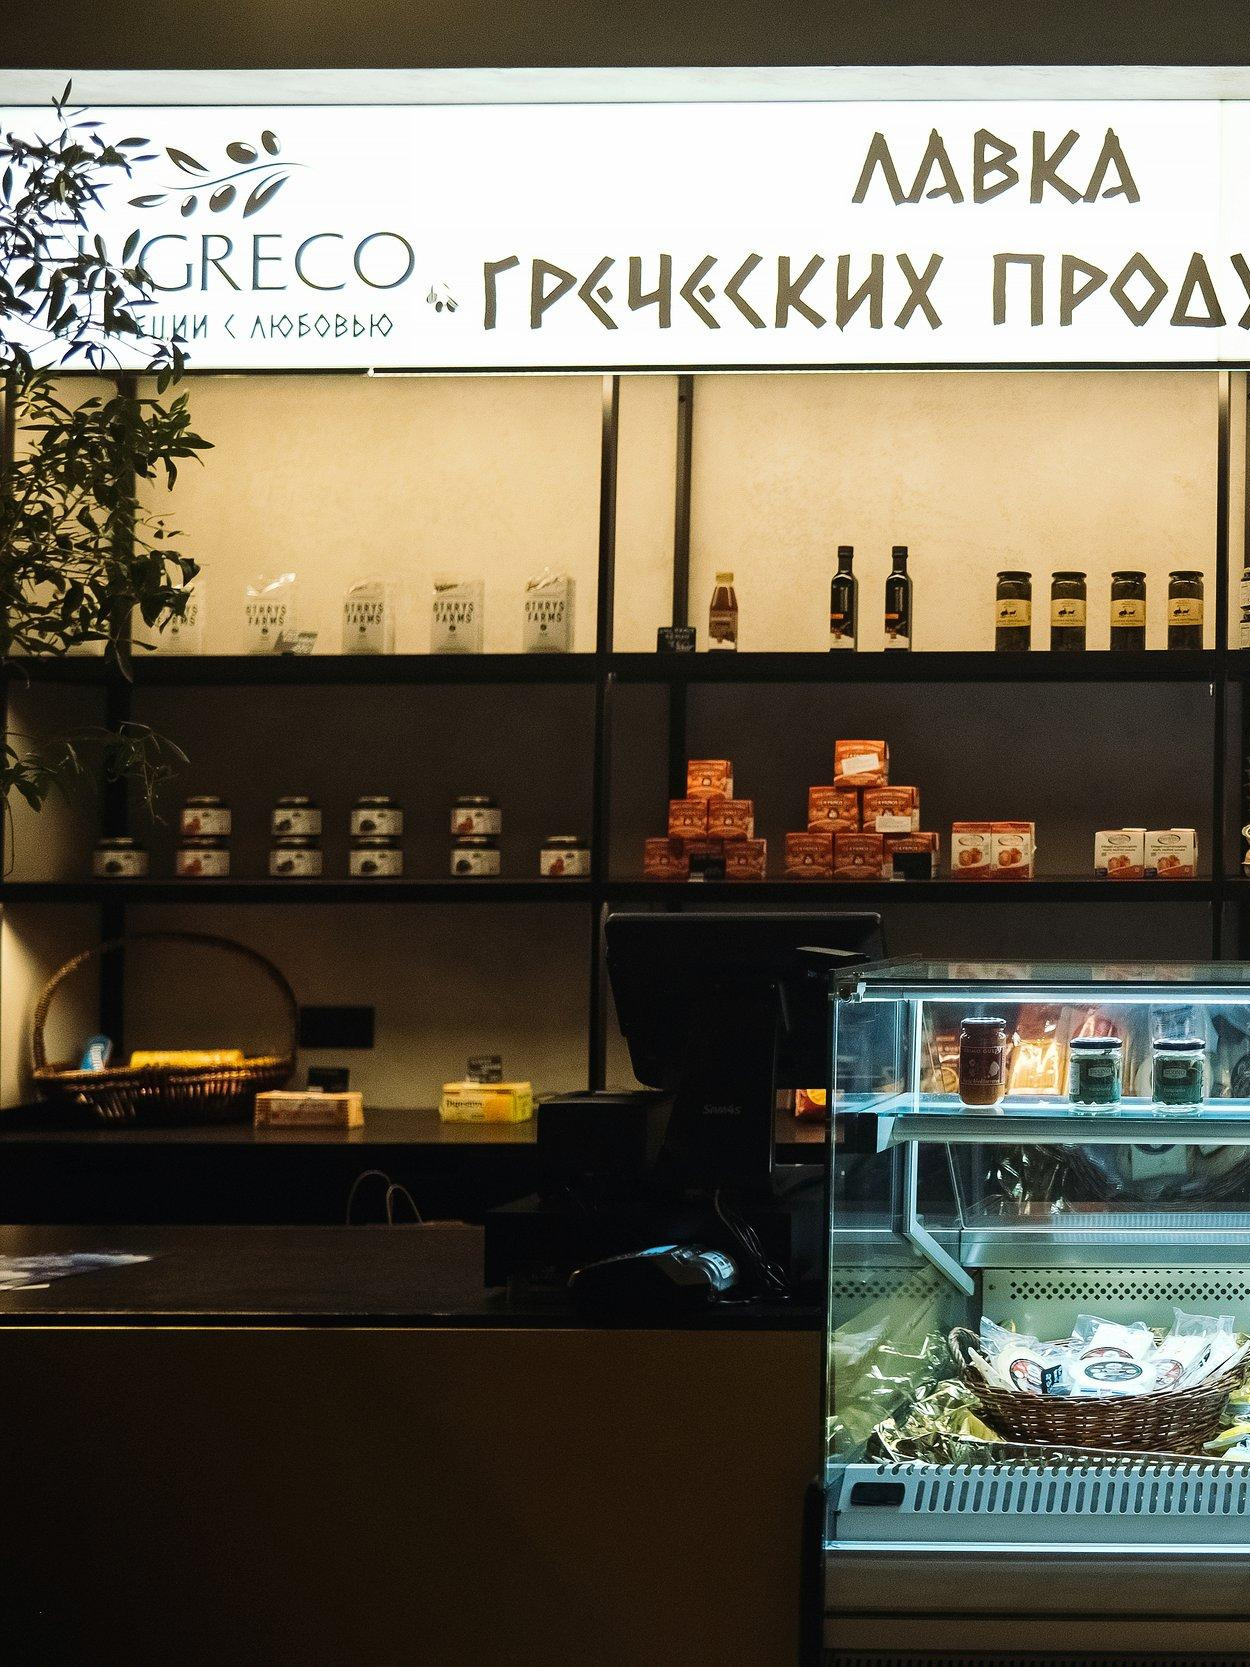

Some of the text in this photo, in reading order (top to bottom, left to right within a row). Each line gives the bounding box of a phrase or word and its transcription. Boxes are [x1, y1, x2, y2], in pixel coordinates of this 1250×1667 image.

[852, 128, 1140, 206] ЛАВКА
[138, 234, 416, 292] GRECO
[484, 253, 944, 332] ГРЕЧЕСКИХ
[224, 313, 236, 339] С
[250, 313, 394, 339] ЛЮБОВЬЮ
